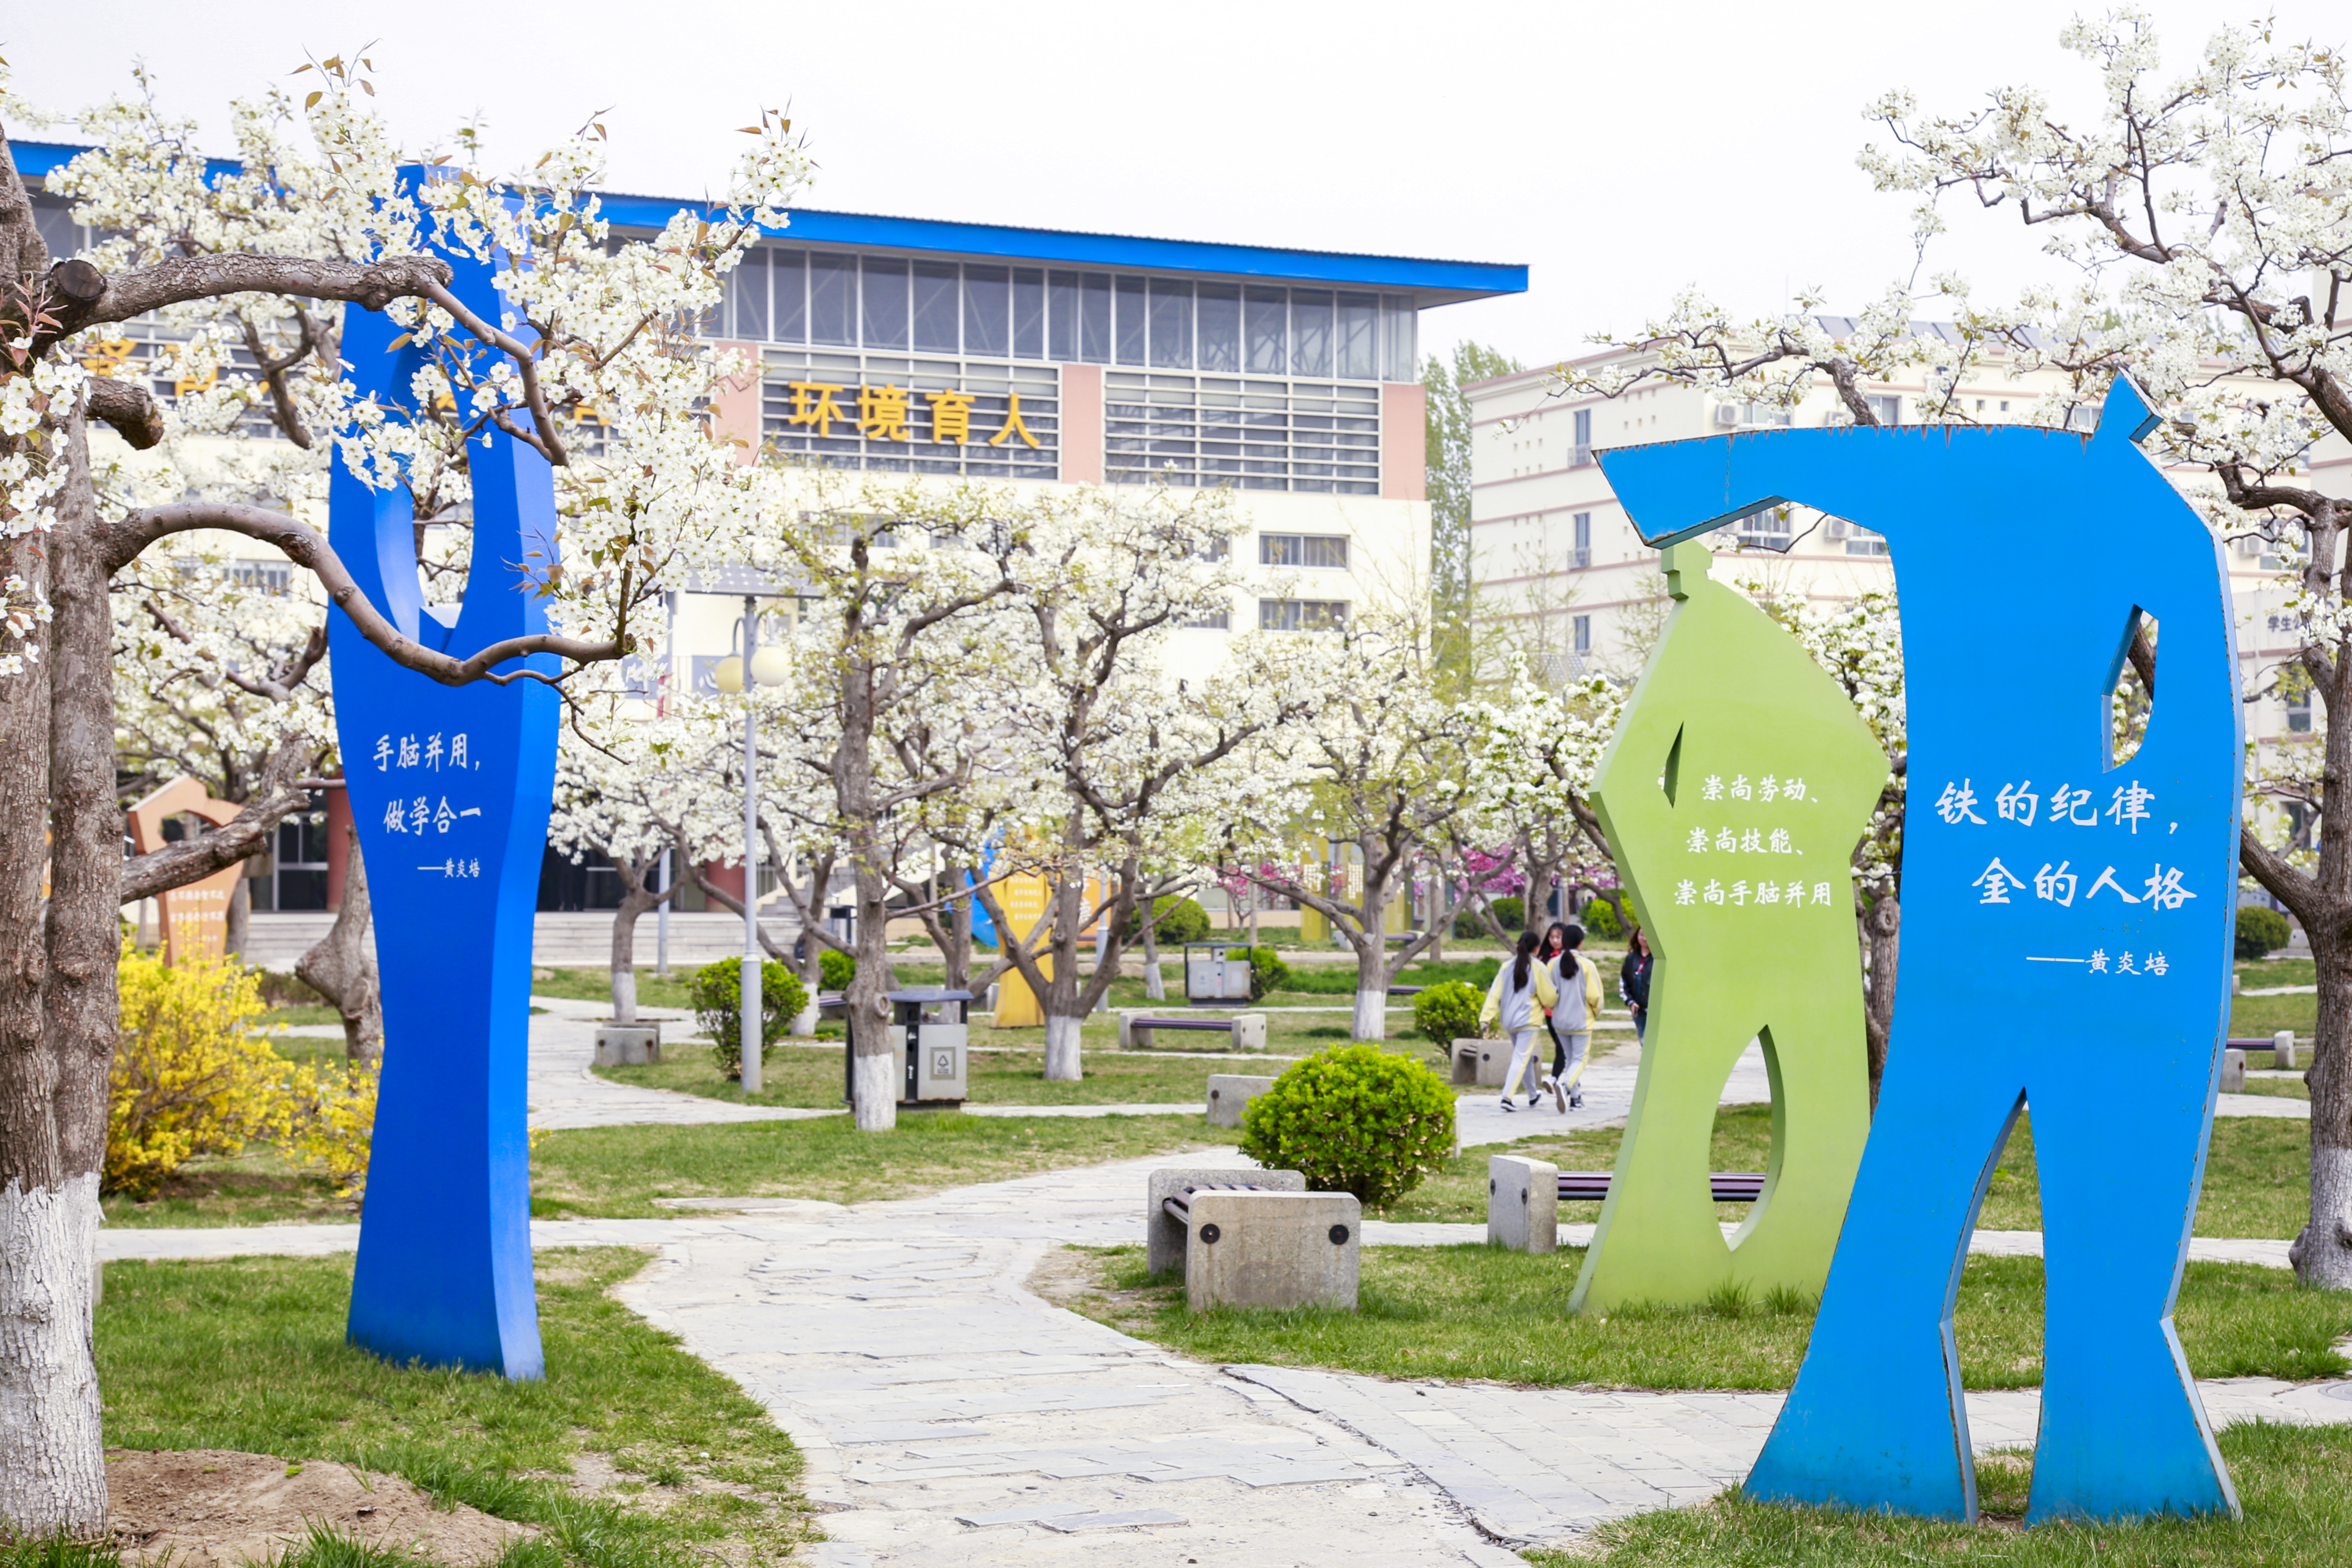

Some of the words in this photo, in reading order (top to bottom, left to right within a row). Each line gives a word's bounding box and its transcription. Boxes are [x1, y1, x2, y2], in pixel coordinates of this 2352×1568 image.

[788, 381, 1041, 449] 环境育人
[1701, 774, 1818, 803] 崇尚劳动、
[383, 796, 482, 836] 做学合一
[1686, 826, 1803, 855] 崇尚技能、
[1674, 879, 1832, 909] 崇尚手脑并用
[1972, 857, 2197, 911] 金的人格
